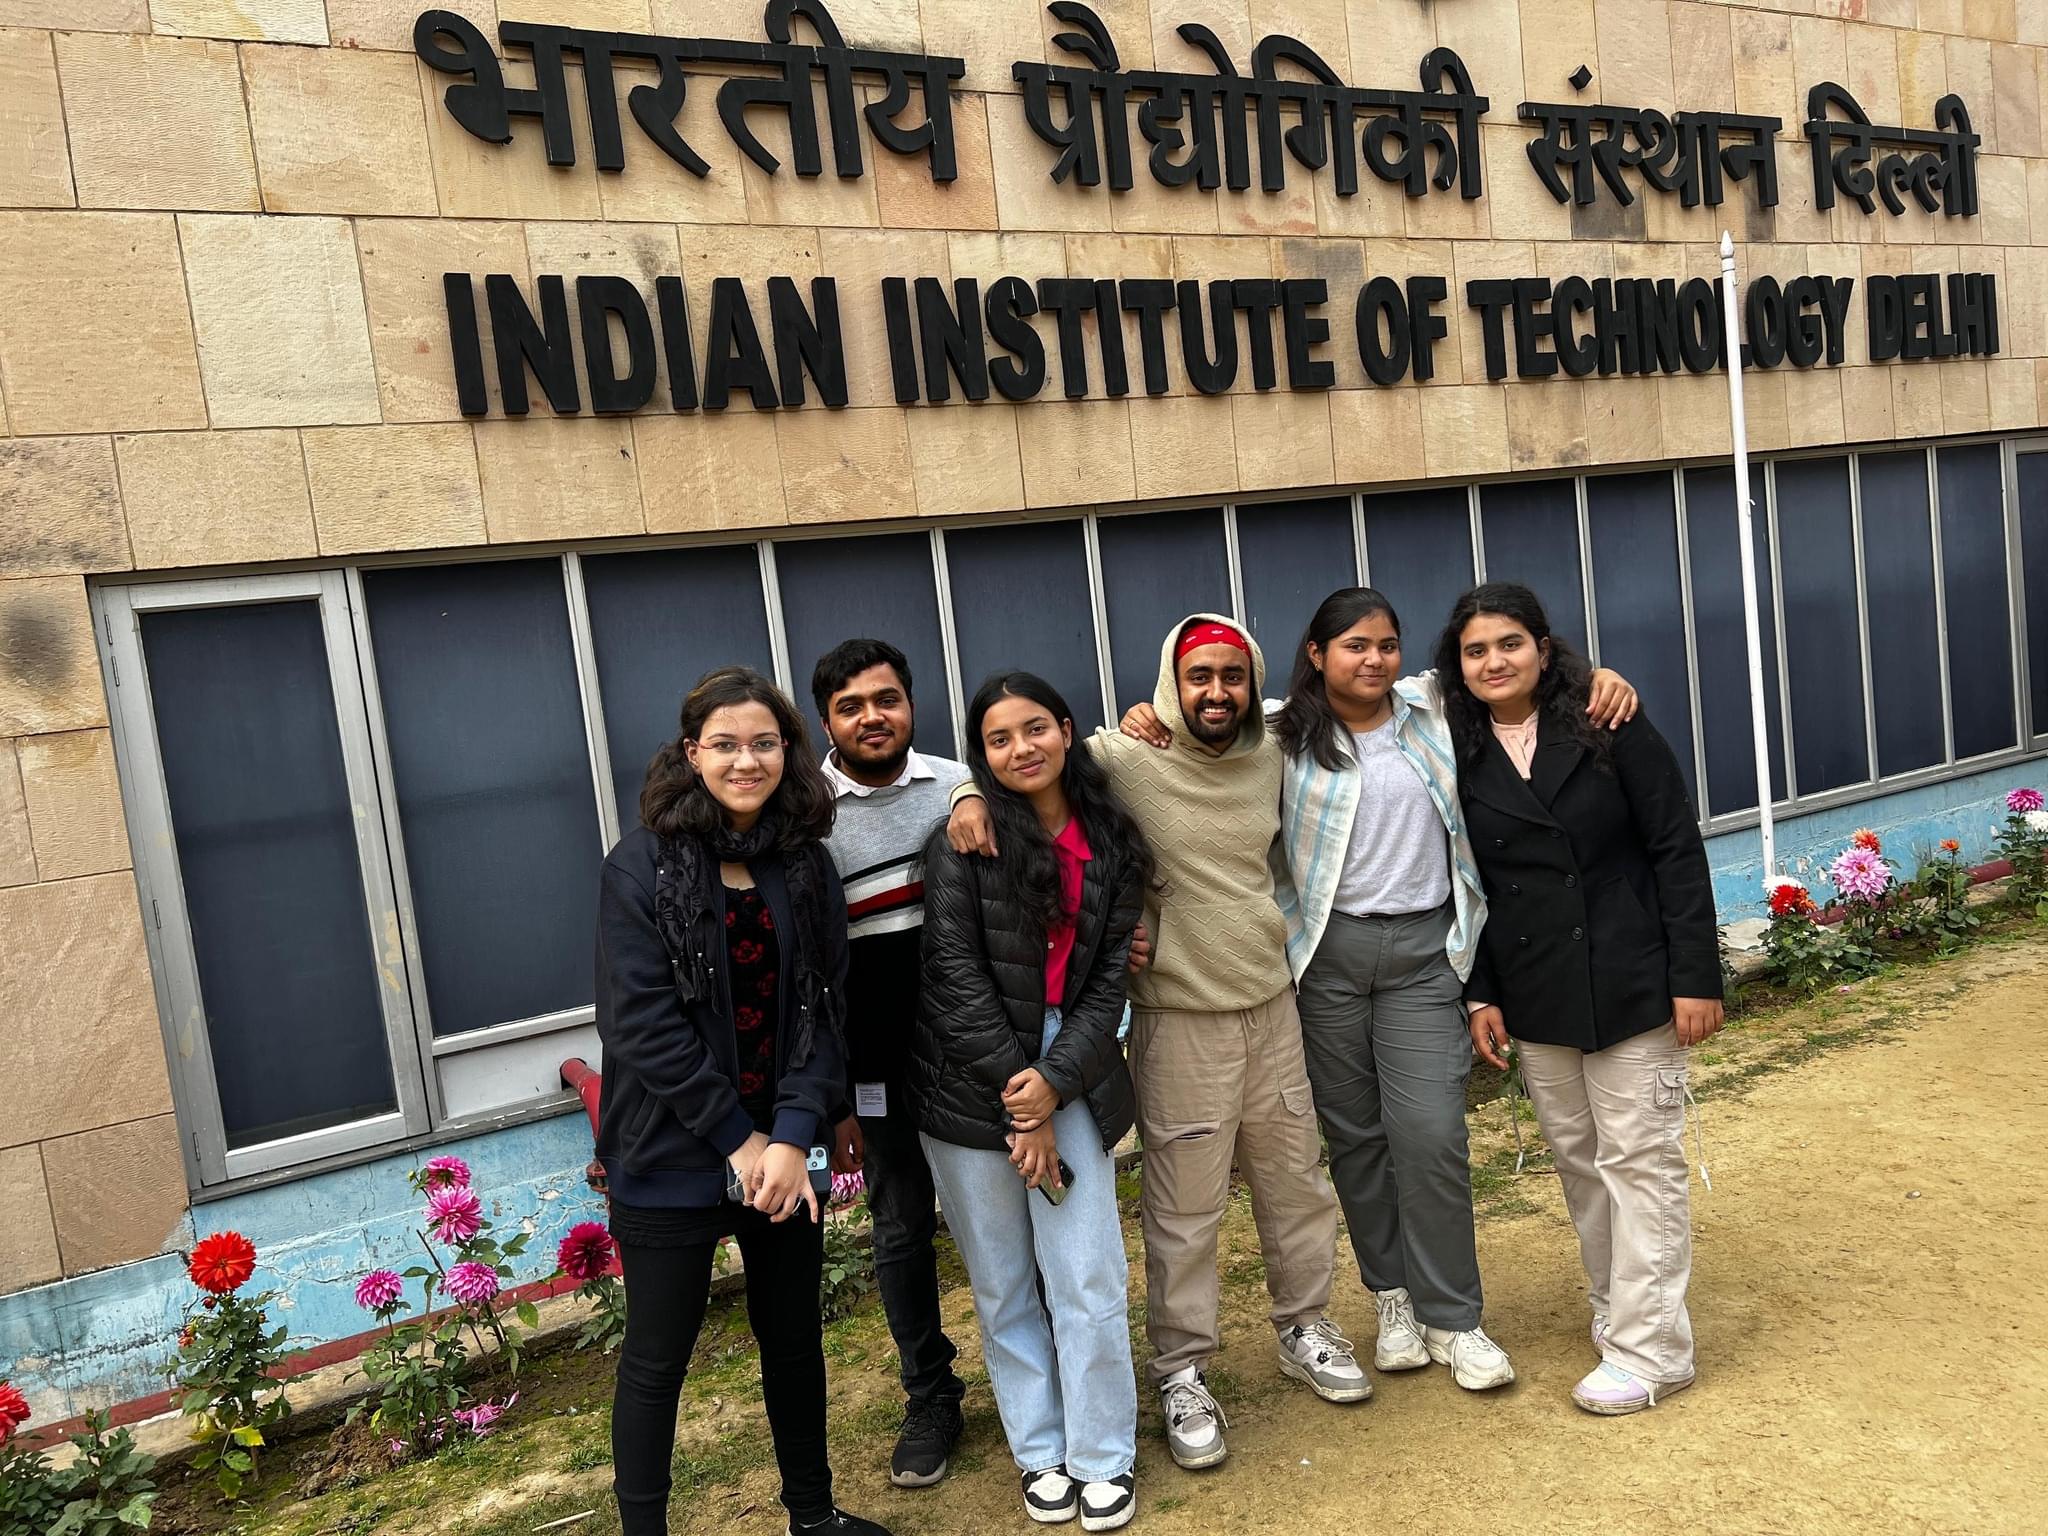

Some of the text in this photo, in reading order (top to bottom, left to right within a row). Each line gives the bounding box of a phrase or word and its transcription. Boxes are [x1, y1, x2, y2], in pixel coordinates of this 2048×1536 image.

[413, 0, 1982, 217] भारतीय प्रौद्योगिकी संस्थान दिल्ली
[443, 273, 2000, 419] INDIAN INSTITUTE OF TECHNOLOGY DELHI
